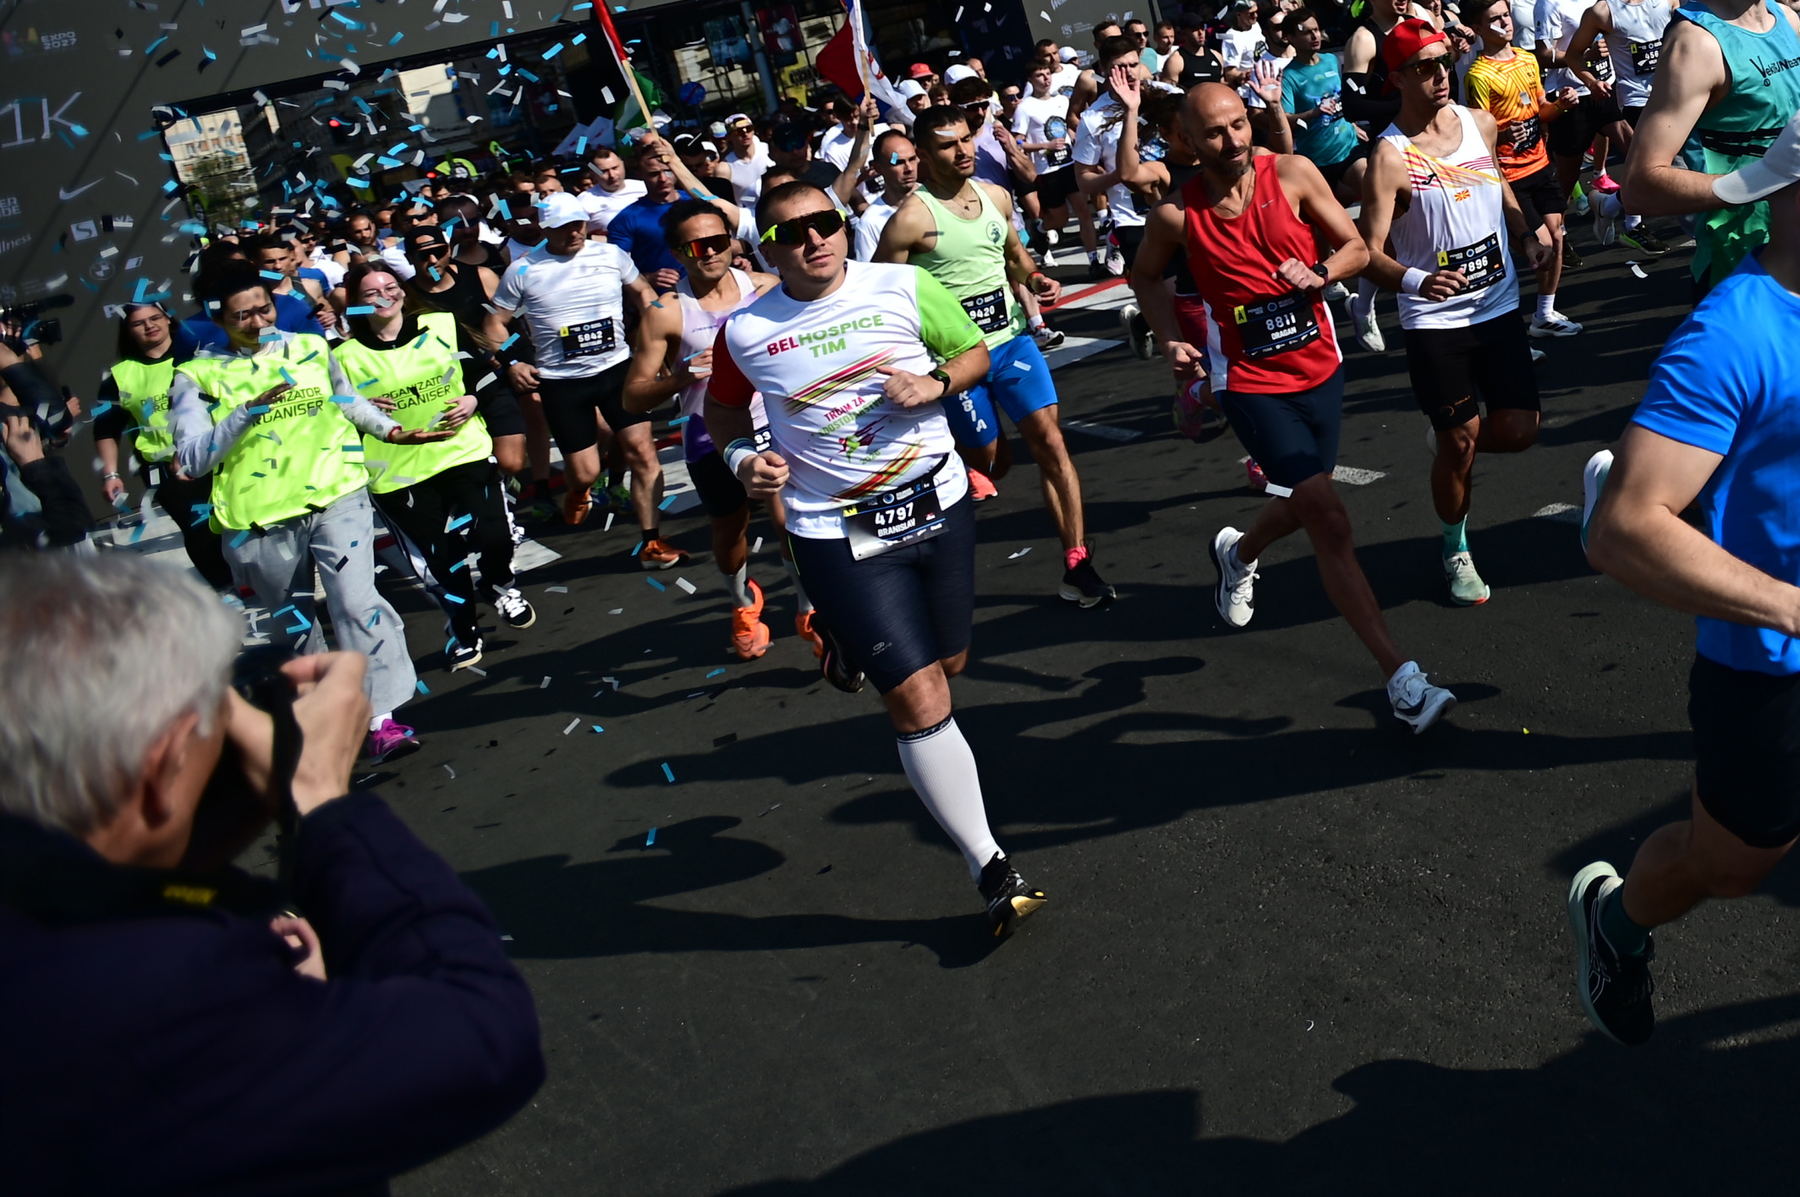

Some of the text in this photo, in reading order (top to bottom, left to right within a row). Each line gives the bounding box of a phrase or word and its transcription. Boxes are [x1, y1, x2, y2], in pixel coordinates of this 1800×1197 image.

[41, 31, 76, 43] EXPO
[1460, 256, 1488, 274] 7896
[969, 305, 995, 320] 9420
[766, 314, 884, 356] BELHOSPICE
[809, 338, 847, 358] TIM
[875, 502, 914, 525] 4797
[877, 518, 916, 537] BRANISLAV
